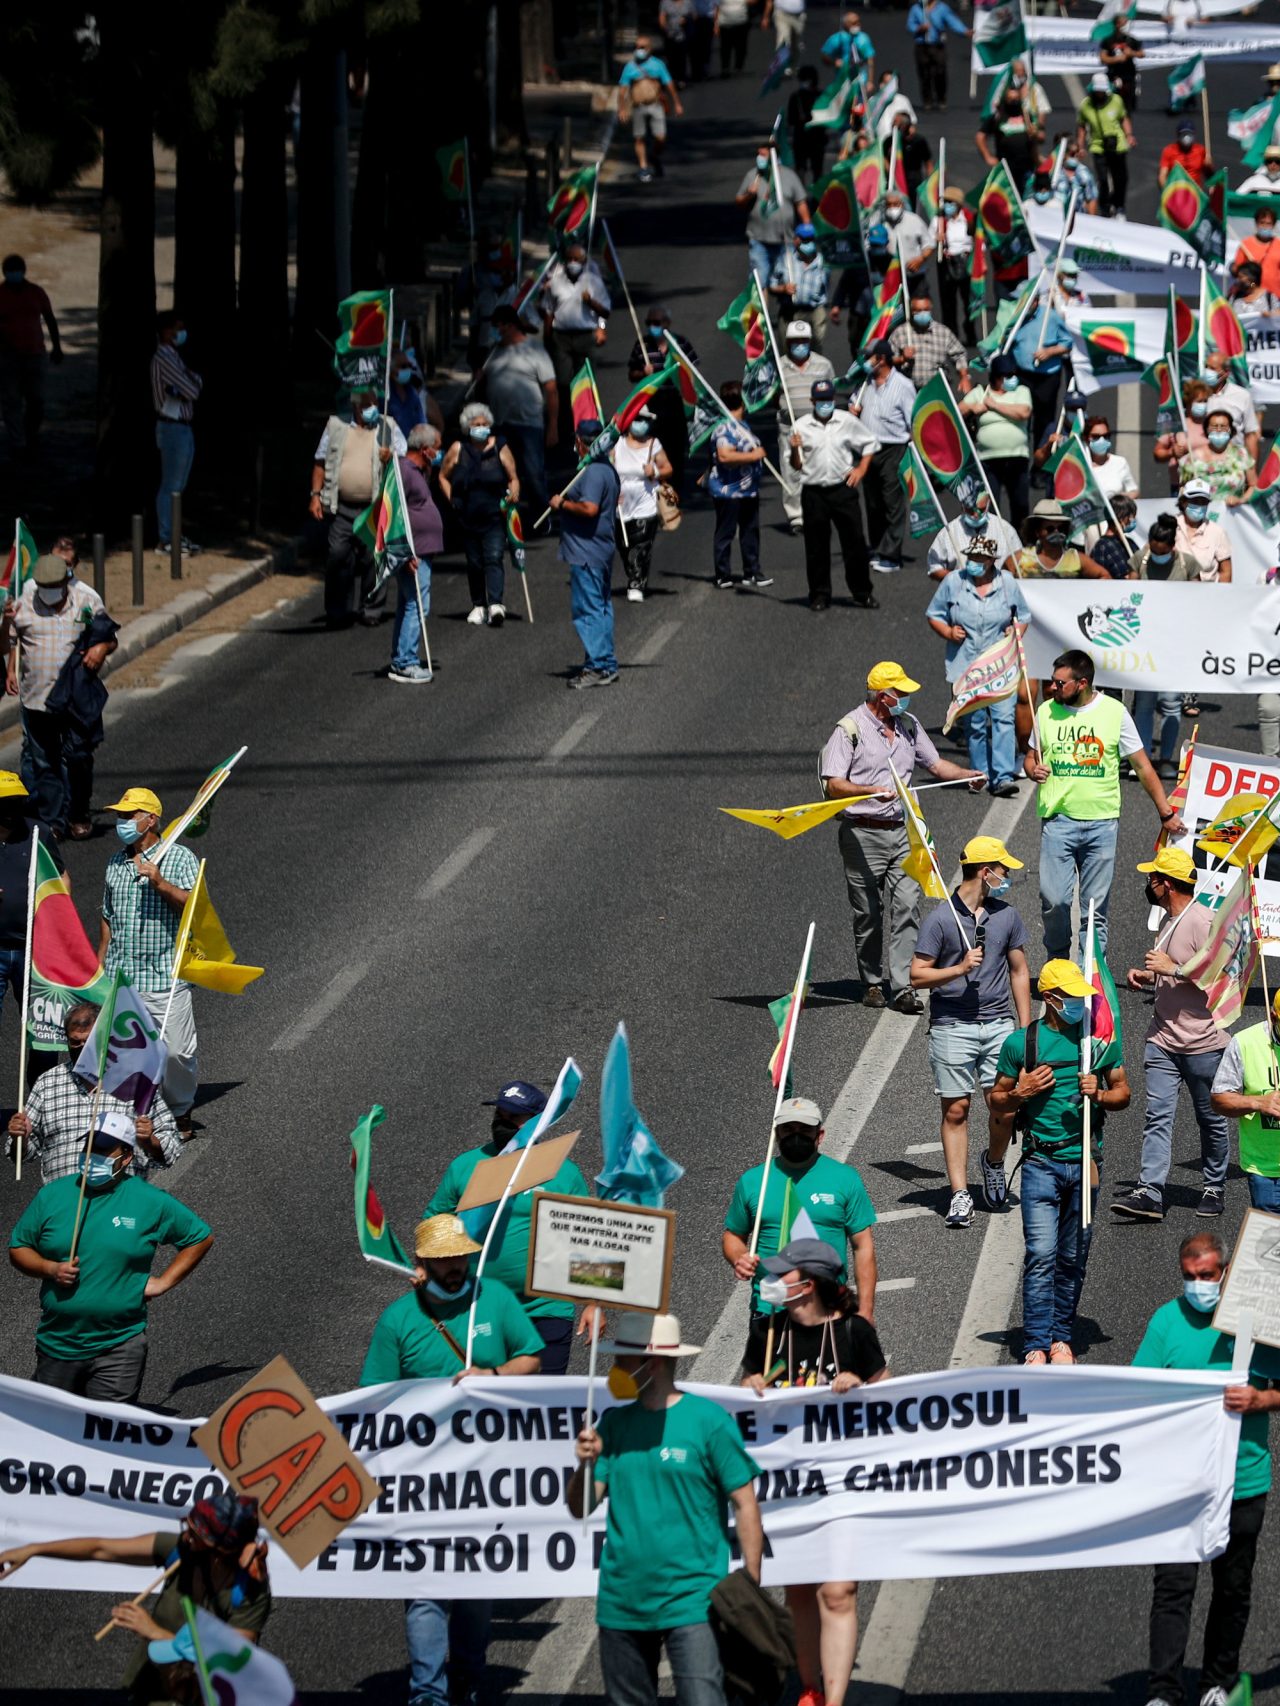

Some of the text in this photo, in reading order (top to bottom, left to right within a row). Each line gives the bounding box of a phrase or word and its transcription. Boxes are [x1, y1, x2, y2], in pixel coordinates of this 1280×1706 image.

[1201, 649, 1235, 676] às
[1057, 726, 1096, 742] UAGA
[549, 1210, 604, 1226] QUEREMOS
[635, 1223, 656, 1234] PAC
[550, 1222, 570, 1233] QUE
[621, 1231, 653, 1245] XENTE
[570, 1237, 631, 1253] NAS ALDEAS
[335, 1412, 437, 1452] TADO
[802, 1388, 1029, 1445] MERCOSUL
[217, 1388, 363, 1538] CAP
[843, 1442, 1122, 1493] CAMPONESES
[352, 1522, 530, 1574] DESTRÓI
[546, 1531, 576, 1572] O
